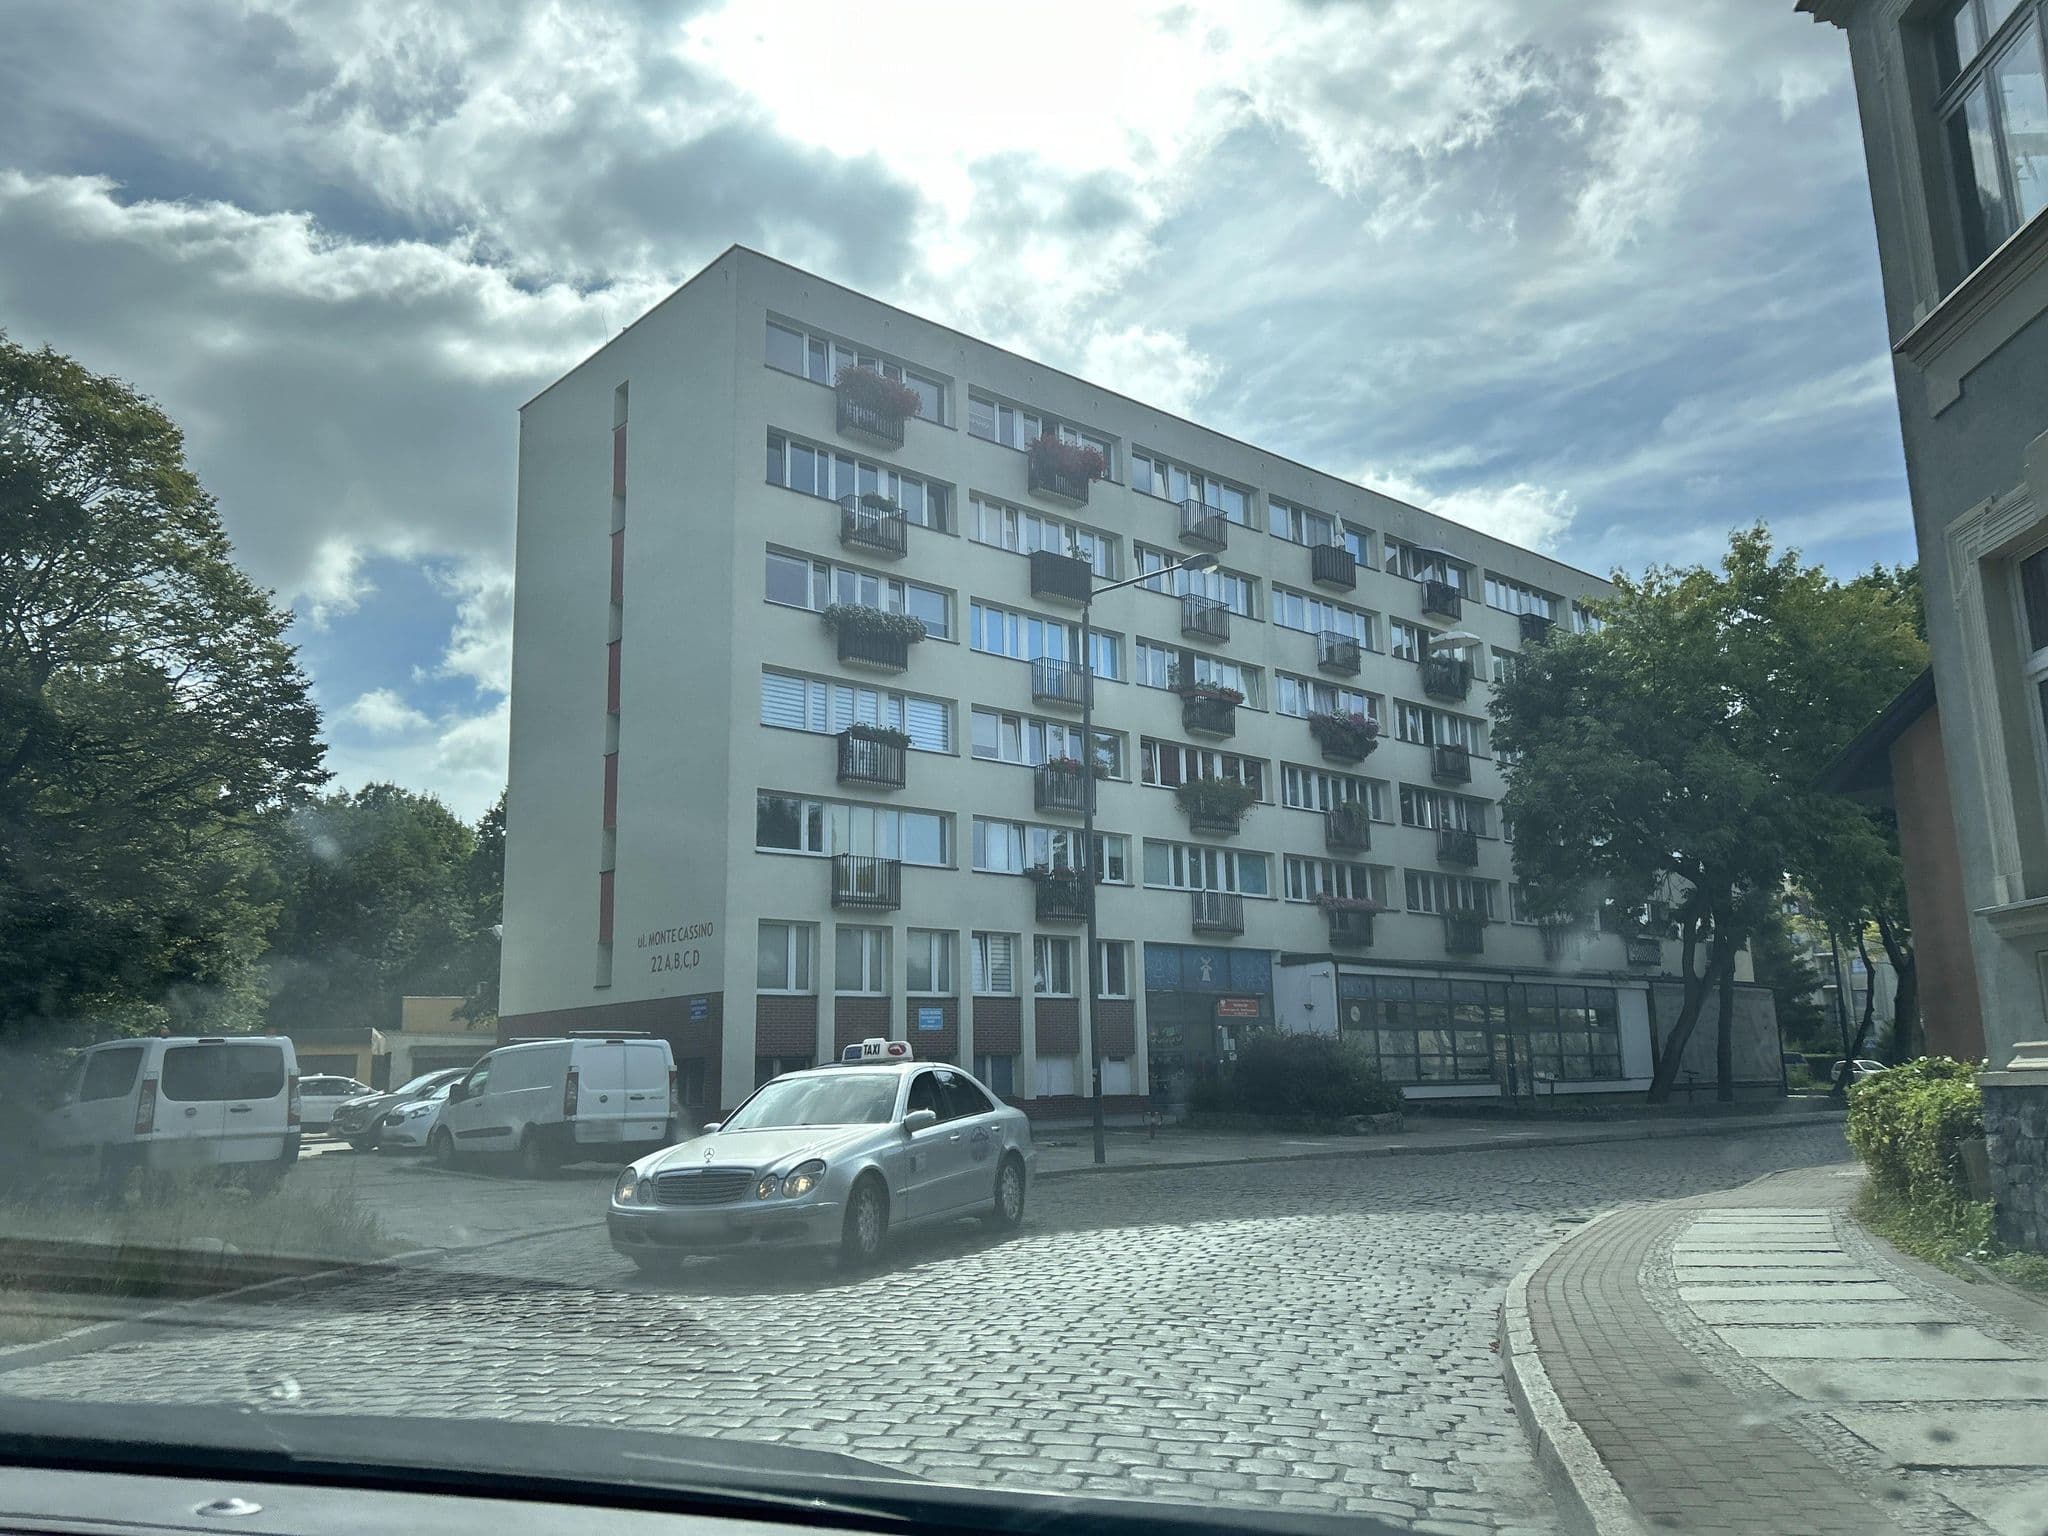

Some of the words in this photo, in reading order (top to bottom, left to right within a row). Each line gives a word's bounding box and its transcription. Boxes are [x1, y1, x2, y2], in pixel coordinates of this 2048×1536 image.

[648, 928, 677, 948] MONTE
[678, 921, 714, 942] CASSINO
[651, 954, 663, 973] 22
[864, 1044, 881, 1056] TAXI
